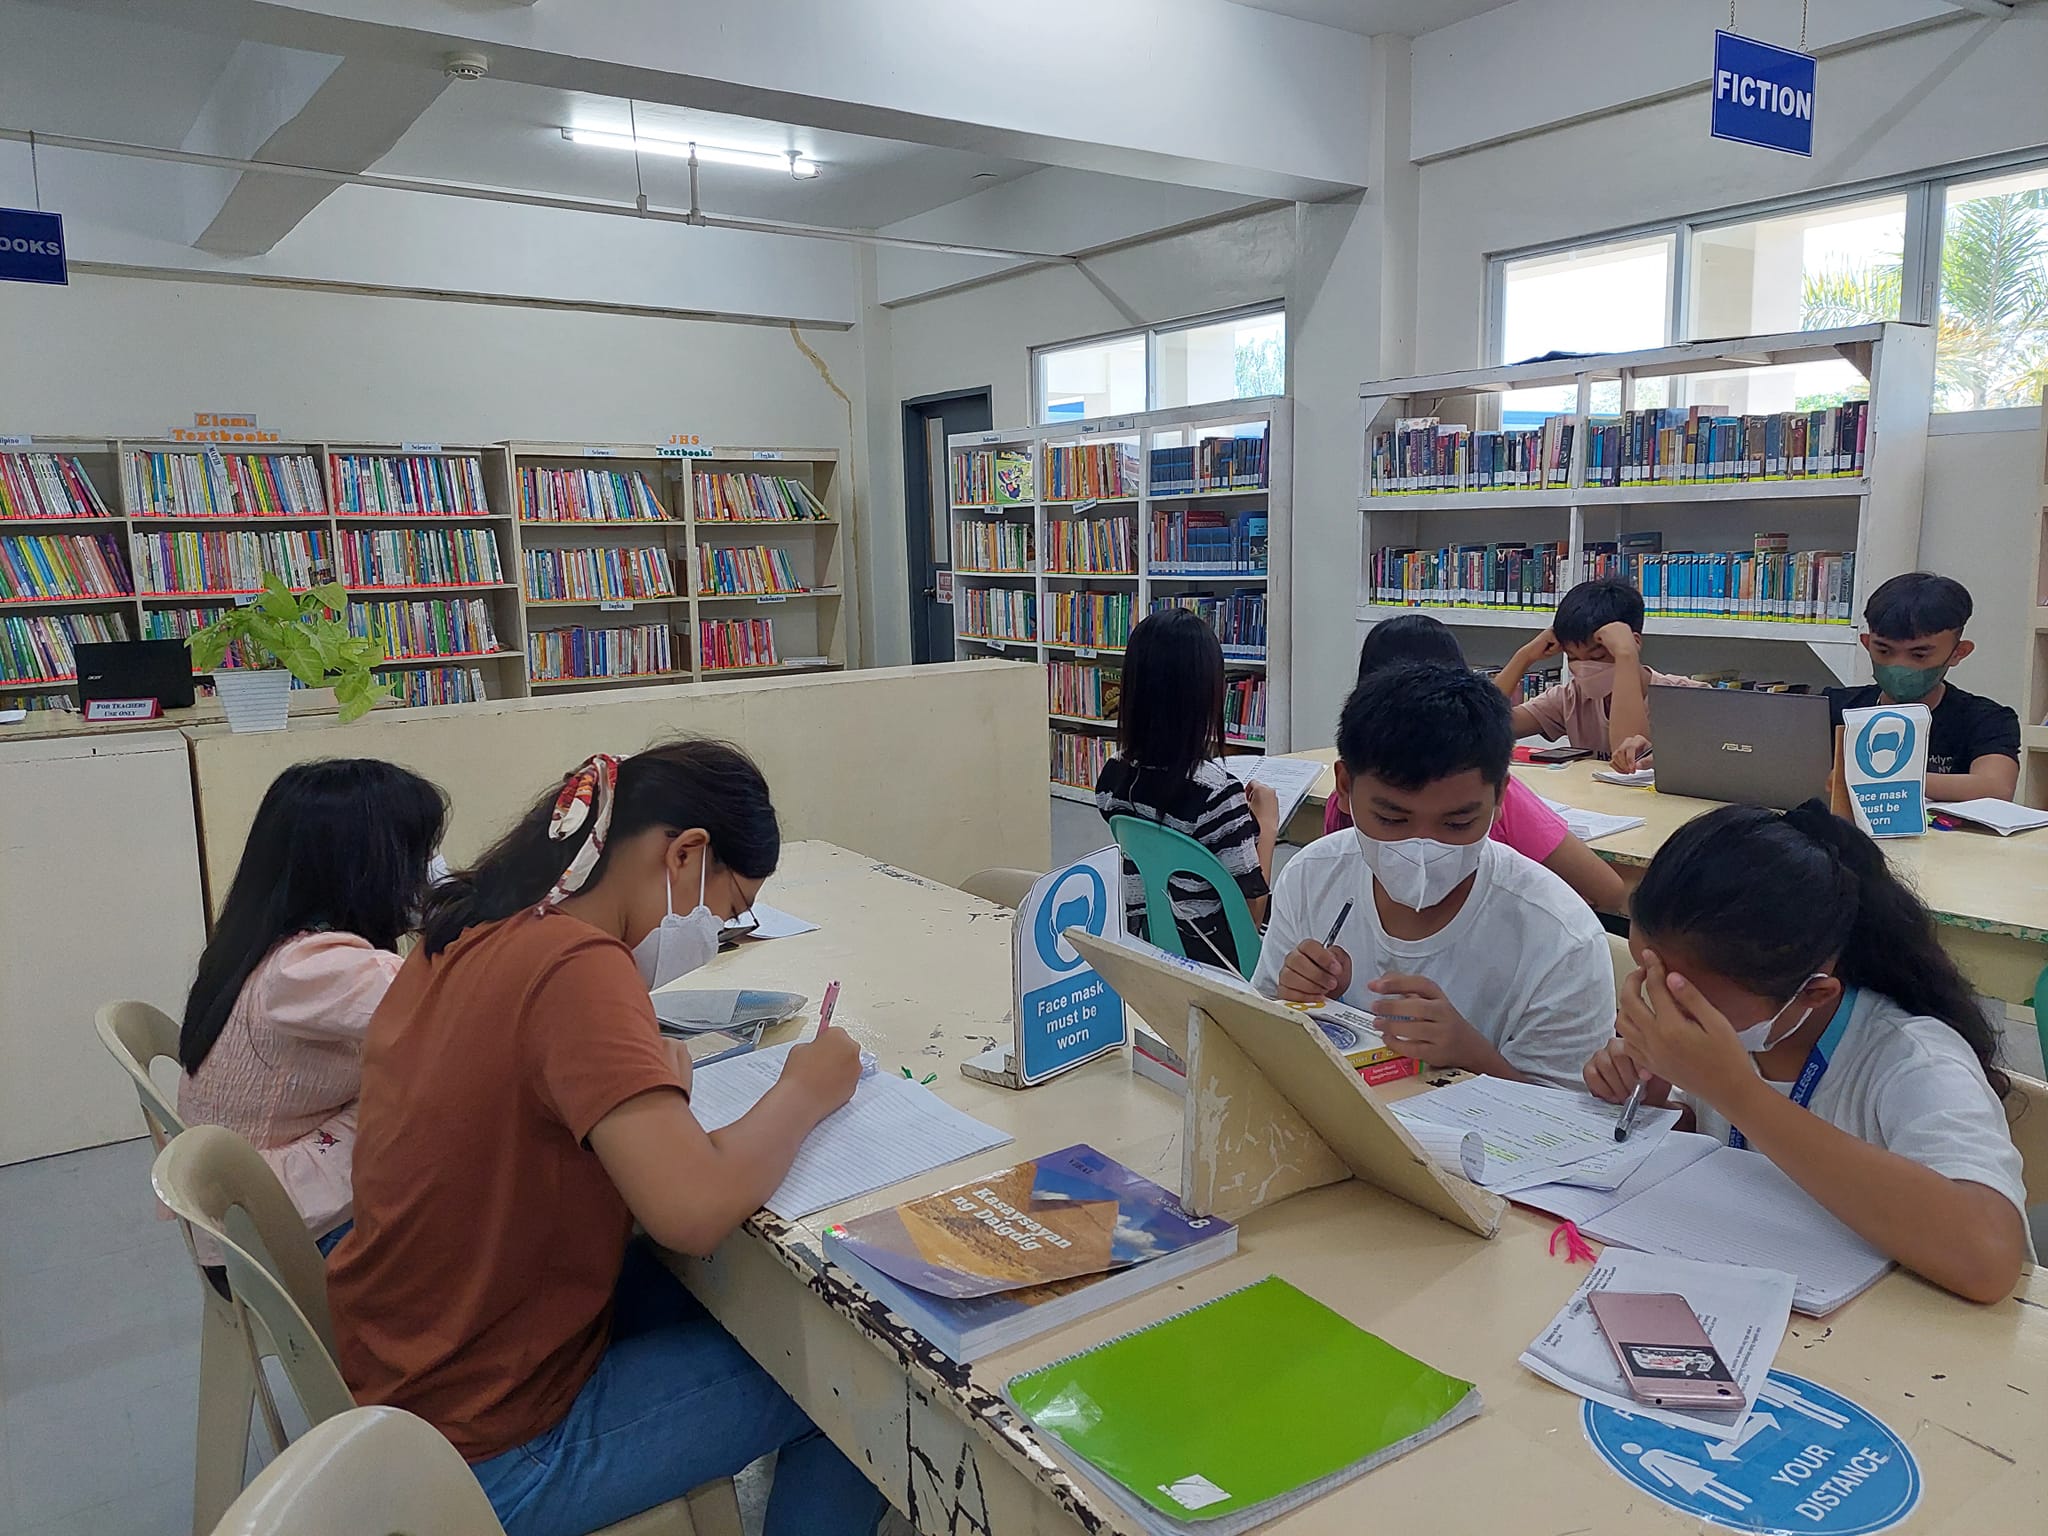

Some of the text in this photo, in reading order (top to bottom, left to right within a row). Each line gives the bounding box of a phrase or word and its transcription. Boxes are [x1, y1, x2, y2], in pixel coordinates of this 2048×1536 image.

[1717, 69, 1812, 121] FICTION
[0, 237, 60, 256] OOKS
[196, 413, 255, 427] Elem.
[172, 428, 279, 442] Textbooks
[668, 434, 700, 445] JHS
[656, 447, 713, 457] Textbooks
[1721, 742, 1753, 753] ASUS
[1880, 789, 1908, 800] mask
[1886, 803, 1900, 812] be
[1870, 817, 1891, 825] orn
[1037, 980, 1104, 1017] Face mask
[1046, 1005, 1097, 1034] must be
[1057, 1028, 1090, 1050] worn
[950, 1196, 1043, 1251] ng Daigdig
[972, 1187, 1072, 1249] Kasaysayan
[1188, 1219, 1211, 1229] 8
[1771, 1444, 1836, 1487] YOUR
[1795, 1447, 1889, 1522] DISTANCE
